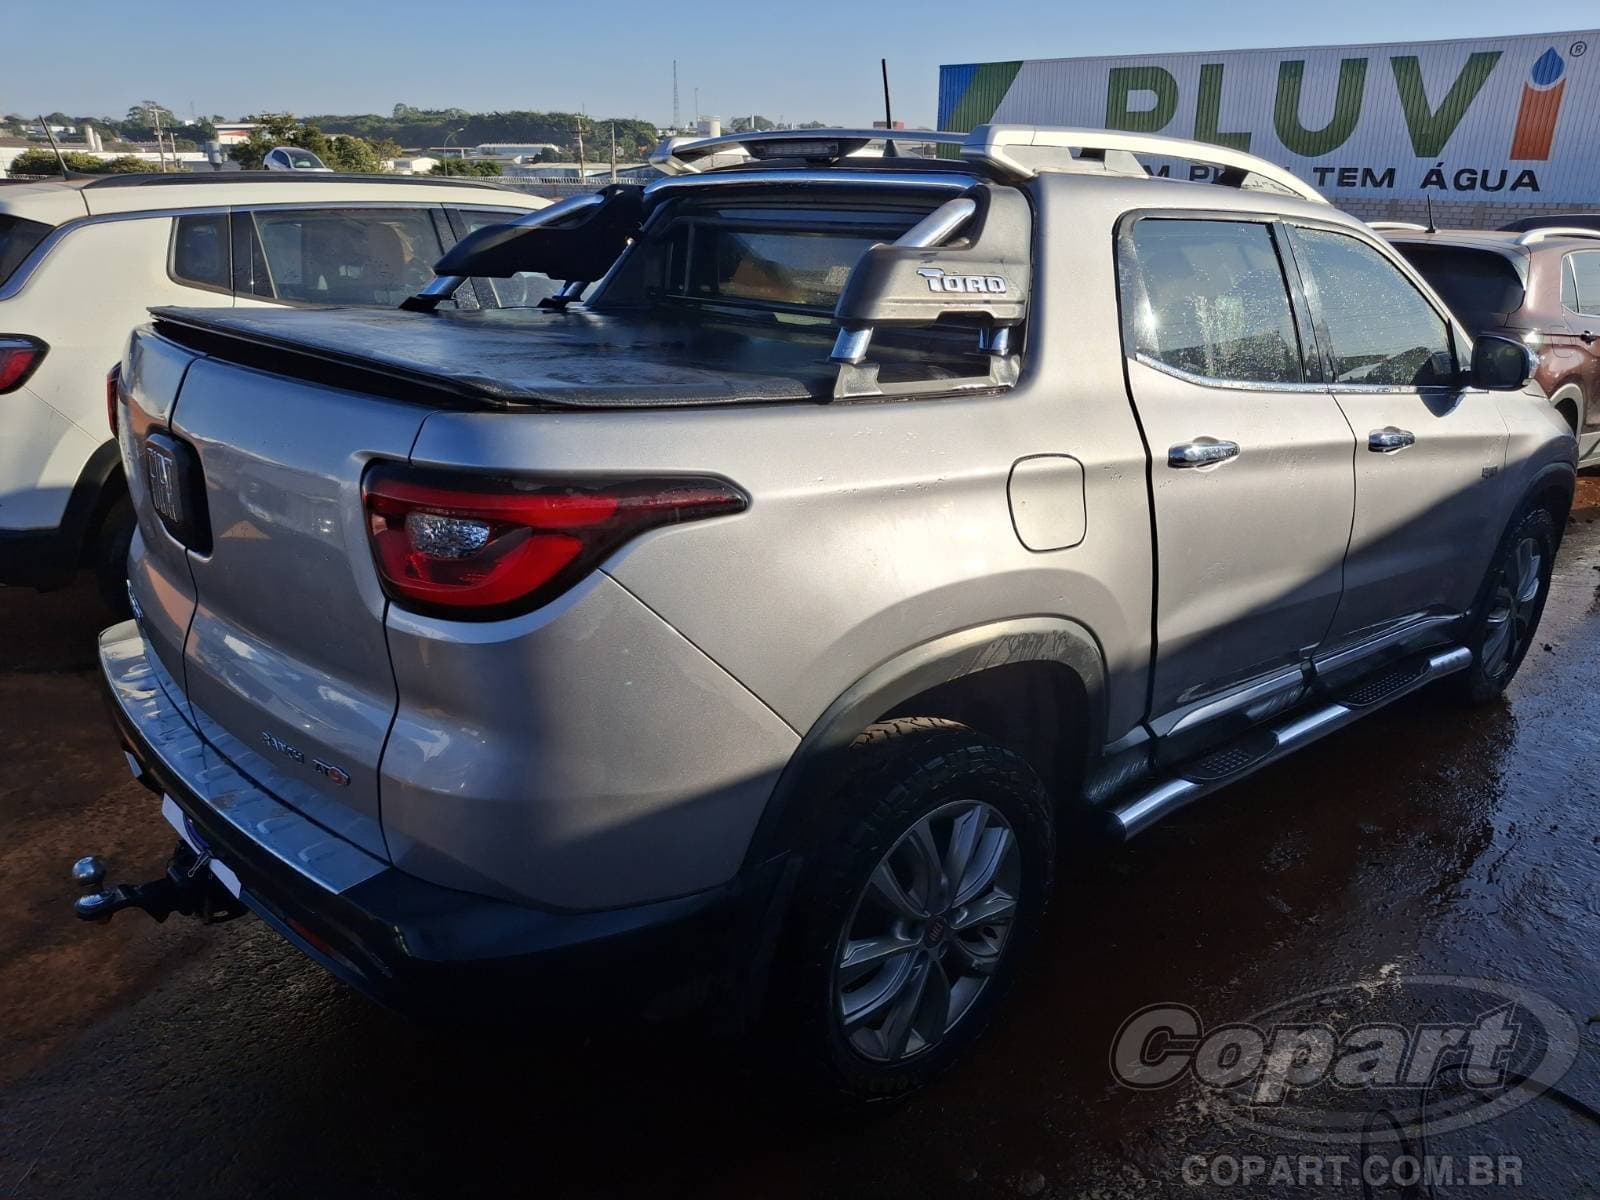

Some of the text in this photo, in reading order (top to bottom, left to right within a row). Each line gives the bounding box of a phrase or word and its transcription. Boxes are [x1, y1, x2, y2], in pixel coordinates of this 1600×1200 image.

[1312, 161, 1541, 193] TEM ÁGUA
[916, 267, 1008, 294] TORO
